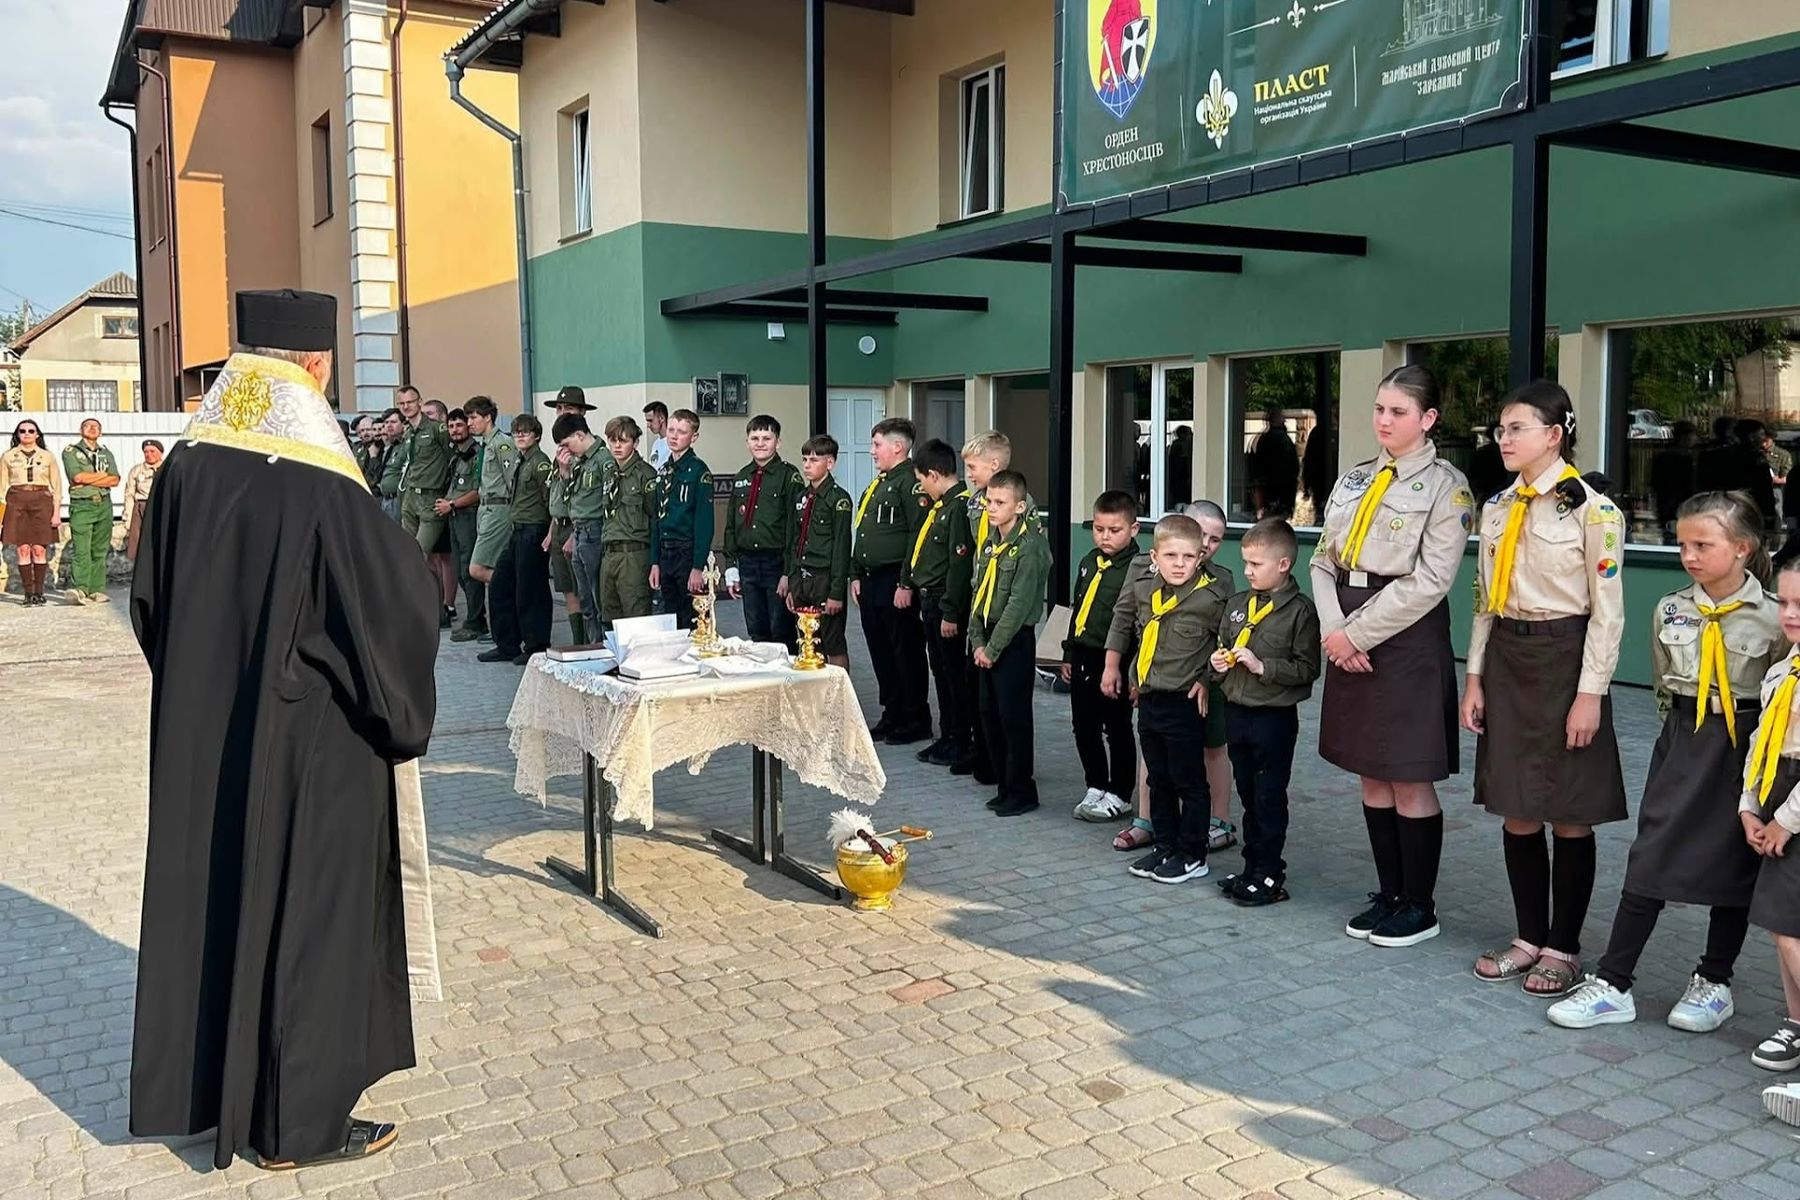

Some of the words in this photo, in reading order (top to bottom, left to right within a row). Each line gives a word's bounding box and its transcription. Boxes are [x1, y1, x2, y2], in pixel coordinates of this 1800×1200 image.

[1430, 46, 1471, 74] ДУХОВНИЙ
[1254, 64, 1330, 103] ПЛАСТ
[1254, 98, 1297, 116] Національна
[1298, 90, 1332, 104] скаутська
[1260, 107, 1299, 125] організація
[1300, 101, 1327, 114] України
[1104, 126, 1139, 150] ОРДЕН
[1083, 142, 1164, 176] ХРЕСТОНОСЦІВ
